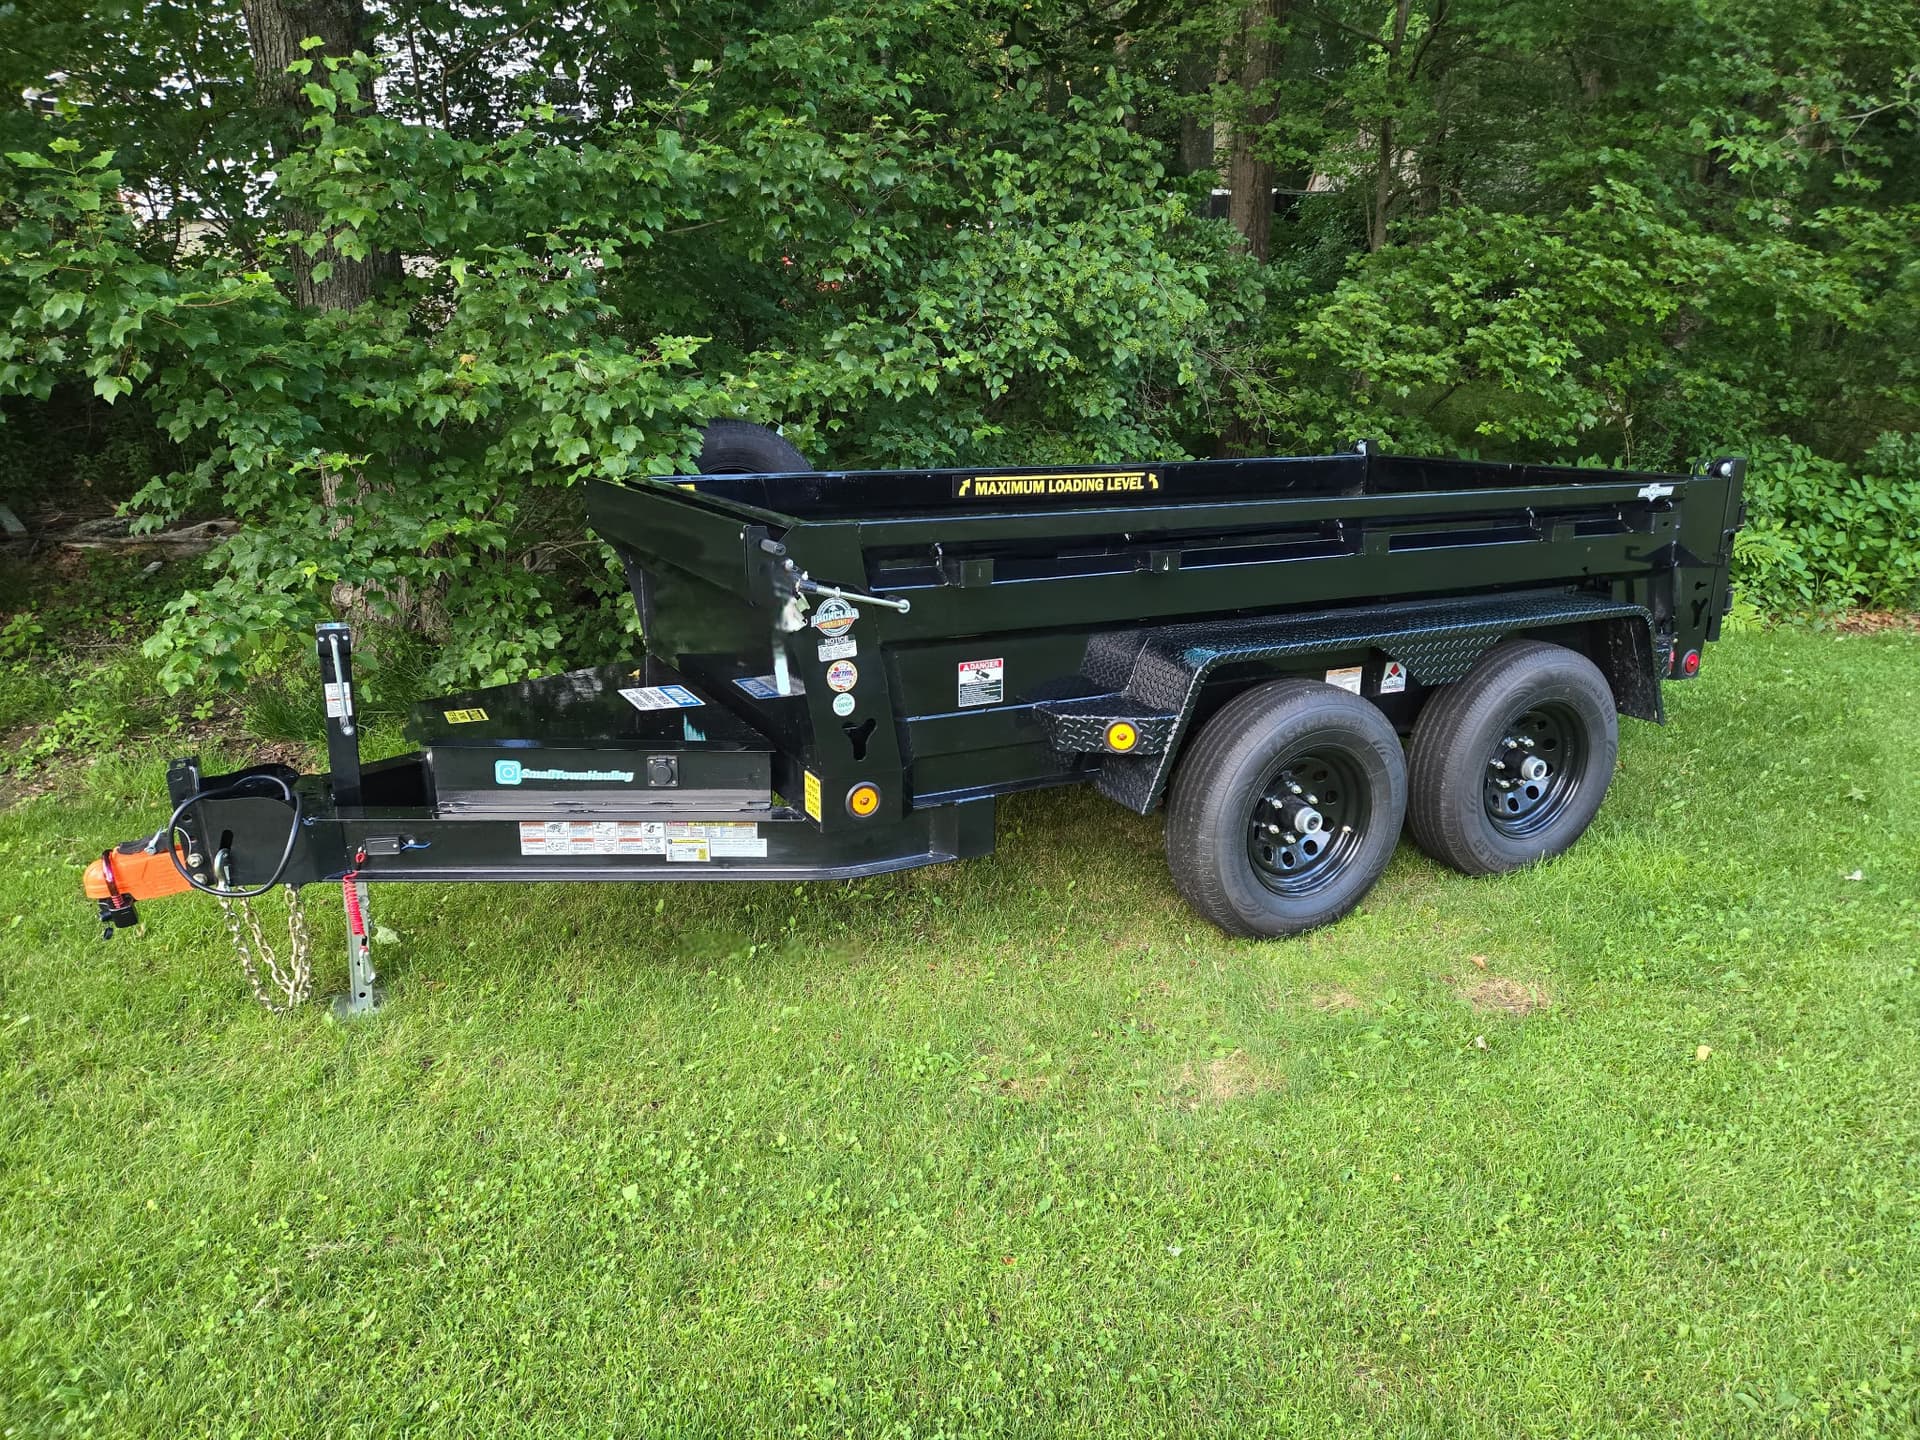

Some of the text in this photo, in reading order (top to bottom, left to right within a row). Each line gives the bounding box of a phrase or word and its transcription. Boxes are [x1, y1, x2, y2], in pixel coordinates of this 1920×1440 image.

[974, 475, 1145, 496] MAXIMUM LOADING LEVEL
[811, 607, 860, 628] IRONCLAD
[824, 635, 849, 646] NOTICE
[969, 660, 998, 671] DANGER
